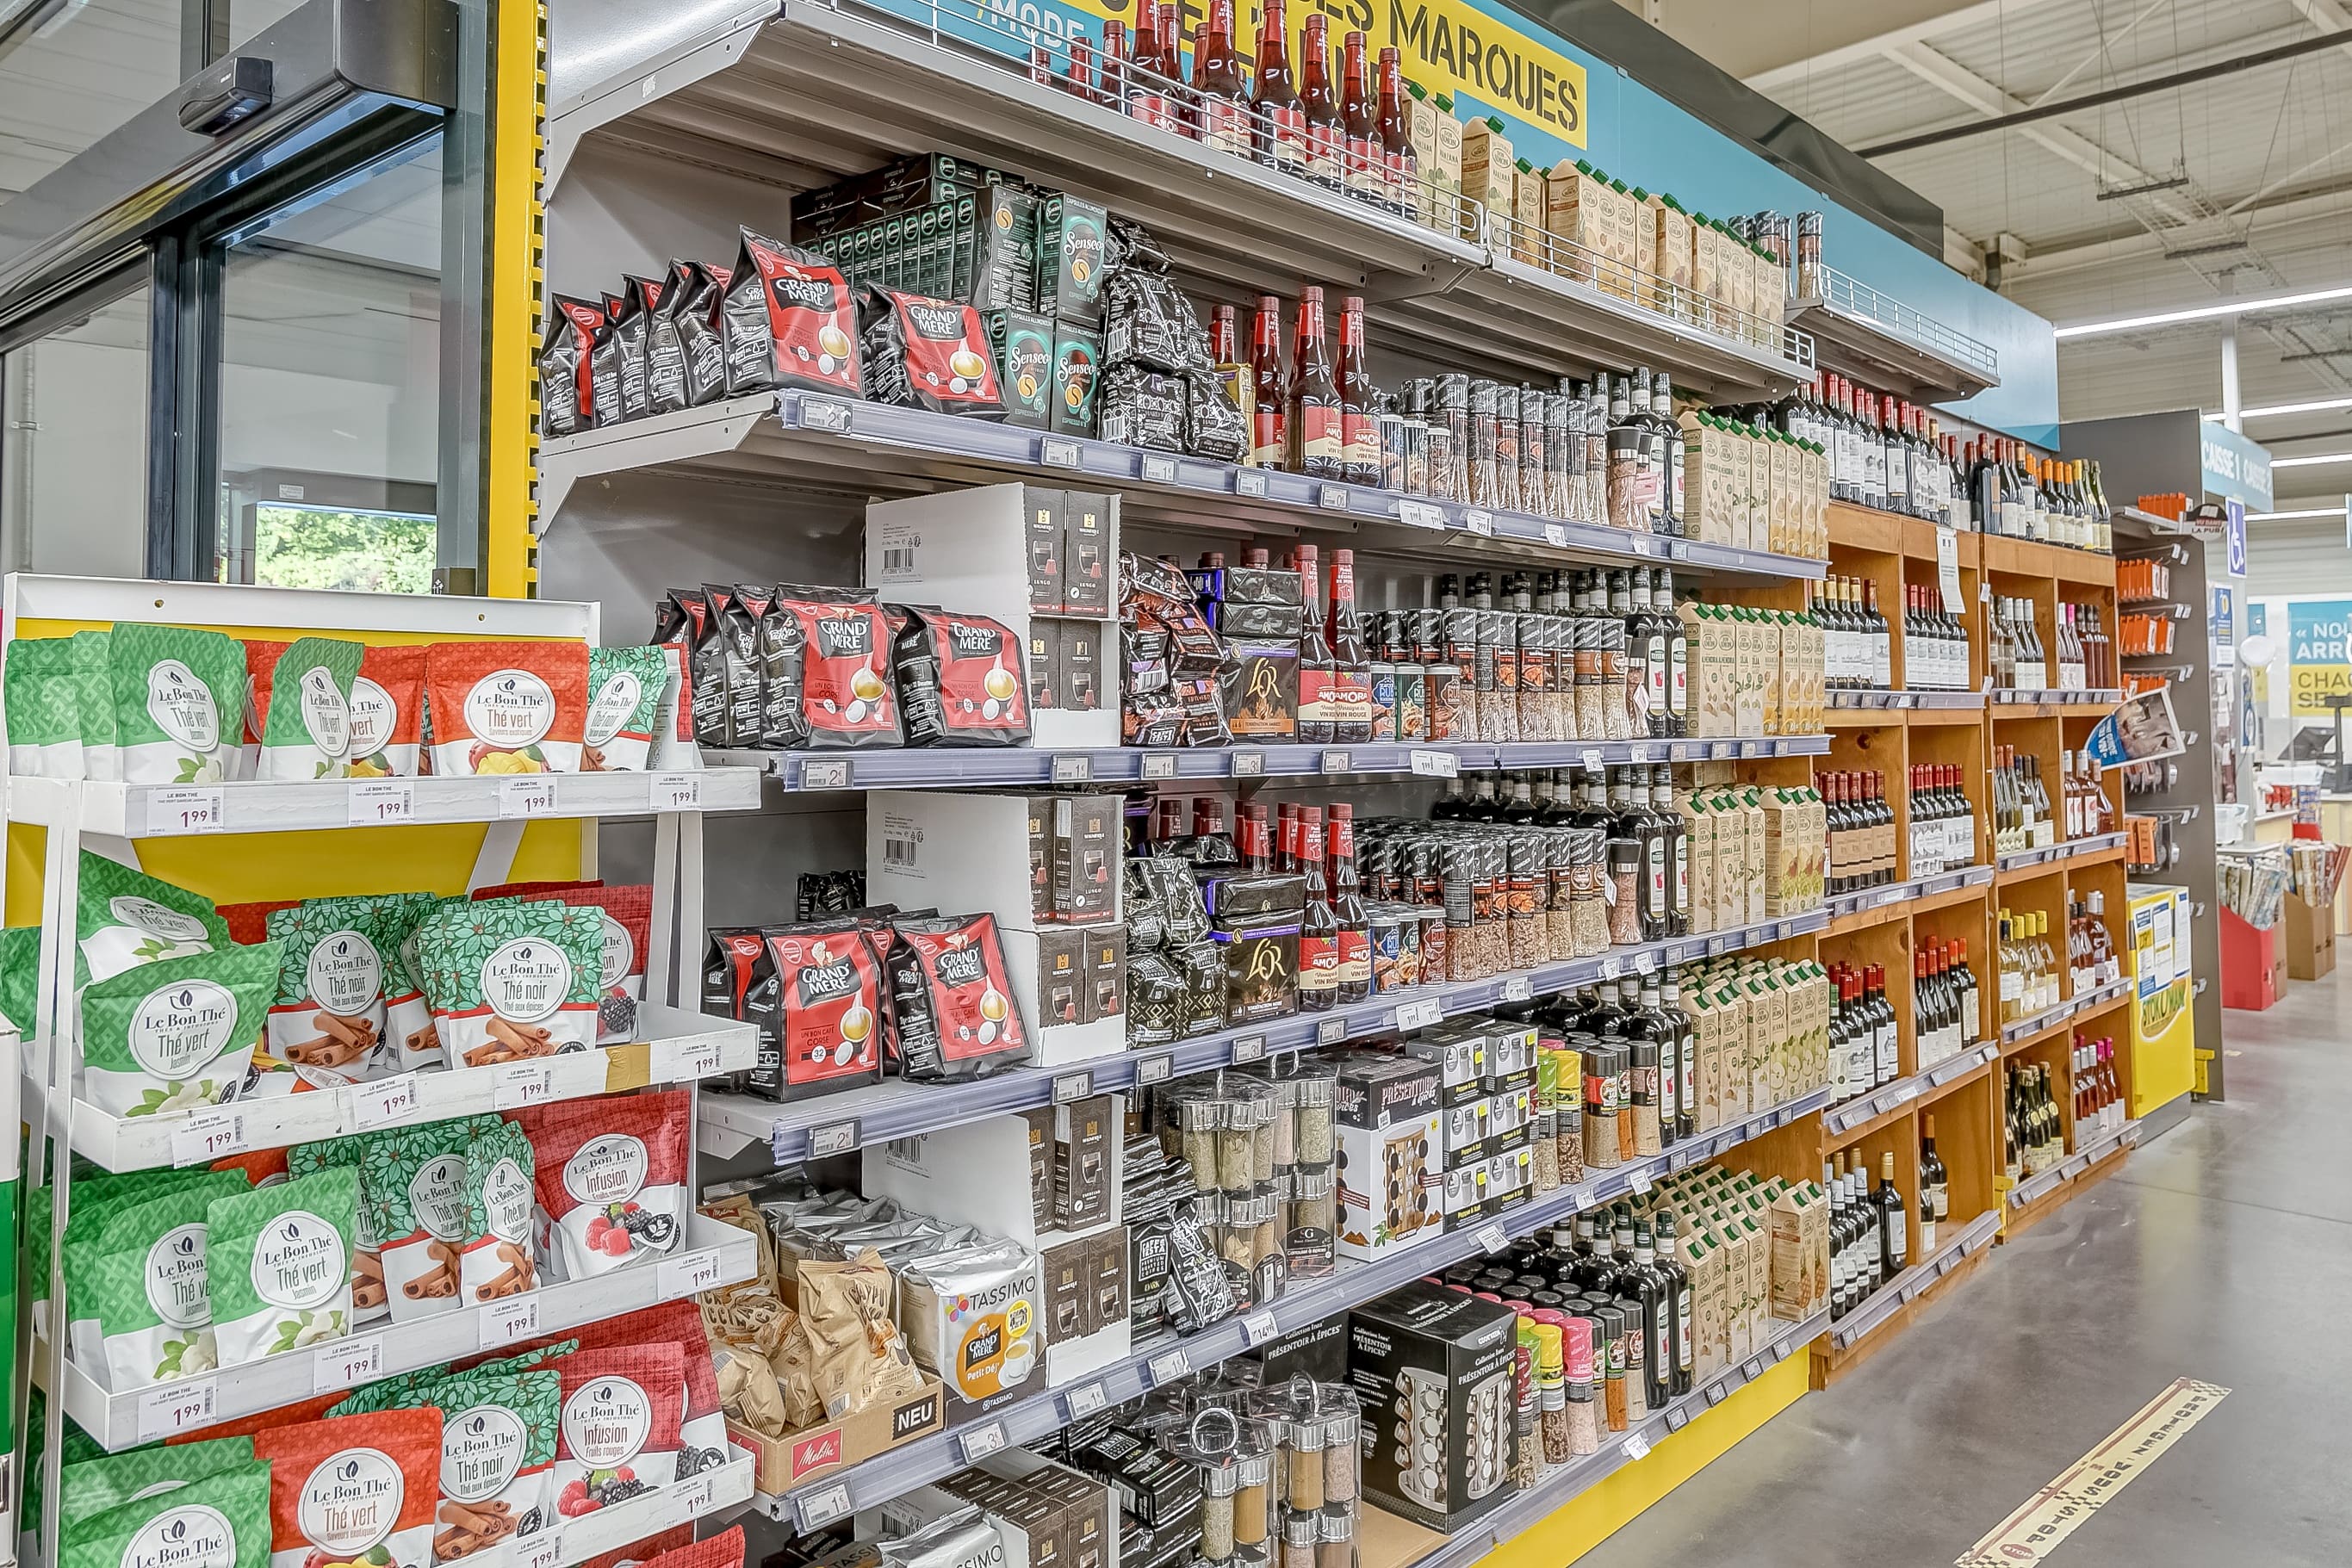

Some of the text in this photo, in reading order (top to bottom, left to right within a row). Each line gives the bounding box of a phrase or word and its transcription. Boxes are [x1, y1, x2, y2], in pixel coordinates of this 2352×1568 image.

[1390, 0, 1579, 131] MARQUES
[1064, 231, 1105, 254] Senseo
[1009, 346, 1051, 372] Senseo
[1057, 357, 1097, 381] Senseo
[1355, 432, 1380, 445] AMOR
[2203, 440, 2234, 480] CAISSE
[2296, 641, 2343, 660] ARR
[158, 688, 207, 703] Le Bon Thé
[357, 699, 383, 711] Thé
[477, 695, 543, 706] Le Bon Thé
[1336, 691, 1368, 703] AMORA
[171, 706, 210, 729] Thé vert
[319, 711, 341, 734] Thé vert
[487, 709, 533, 728] Thé vert
[317, 955, 372, 974] Le Bon Thé
[1313, 957, 1338, 970] AMOR
[1350, 949, 1370, 960] AMOR
[493, 963, 560, 977] Le Bon Thé
[327, 973, 367, 997] Thé noir
[503, 979, 547, 1001] Thé noir
[146, 1007, 226, 1029] Le Bon Thé
[158, 1028, 210, 1057] Thé vert
[807, 1036, 830, 1045] CORSE
[814, 1048, 824, 1057] 32
[573, 1148, 636, 1175] Le Bon Thé
[585, 1168, 629, 1194] Infusion
[489, 1193, 500, 1205] Le
[500, 1187, 514, 1203] Bon
[431, 1201, 450, 1224] Thé
[503, 1205, 518, 1226] Thé
[264, 1233, 332, 1266] Le Bon Thé
[158, 1259, 204, 1279] Le Bon
[276, 1256, 328, 1292] Thé vert
[969, 1275, 1035, 1311] TASSIMO
[1286, 1325, 1310, 1340] Collection
[1269, 1336, 1310, 1360] PRÉSENTOIR
[966, 1367, 985, 1382] Petit
[1458, 1361, 1493, 1385] PRÉSENTOIR
[990, 1391, 1014, 1407] TASSIMO
[573, 1404, 639, 1421] Le Bon Thé
[897, 1402, 933, 1431] NEU
[444, 1431, 517, 1458] Le Bon Thé
[584, 1422, 628, 1447] Infusion
[797, 1442, 836, 1468] Melitta
[456, 1453, 505, 1483] Thé noir
[313, 1477, 391, 1503] Le Bon Thé
[324, 1503, 378, 1532] Thé vert
[135, 1536, 222, 1568] Le Bon Thé
